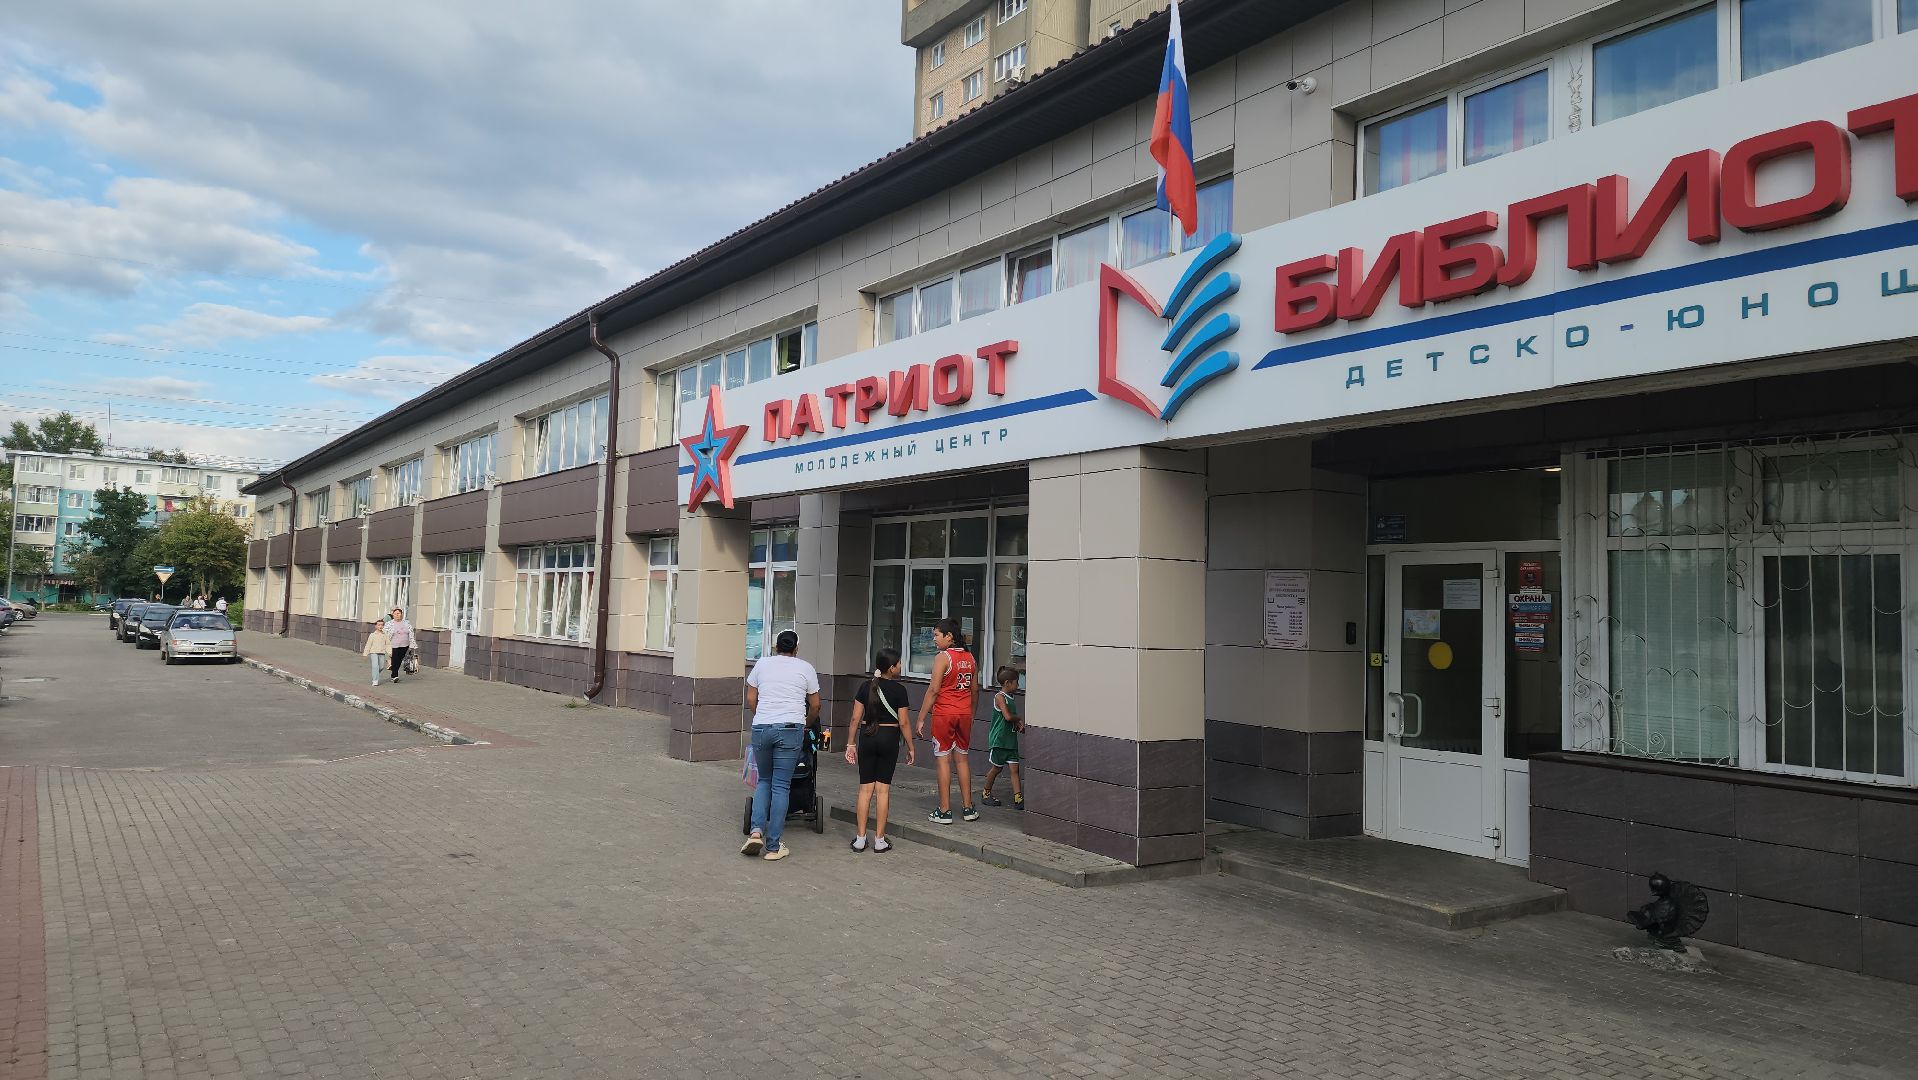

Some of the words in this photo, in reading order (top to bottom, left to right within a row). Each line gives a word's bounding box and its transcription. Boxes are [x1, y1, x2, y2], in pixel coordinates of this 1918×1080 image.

[1274, 94, 1918, 334] БИБЛИОТ
[763, 340, 1018, 443] ПАТРИОТ
[795, 440, 917, 473] МОЛОДЕЖНЫЙ
[935, 428, 1009, 454] ЦЕНТР
[1514, 595, 1546, 603] ОХРАНА
[956, 673, 972, 689] 23
